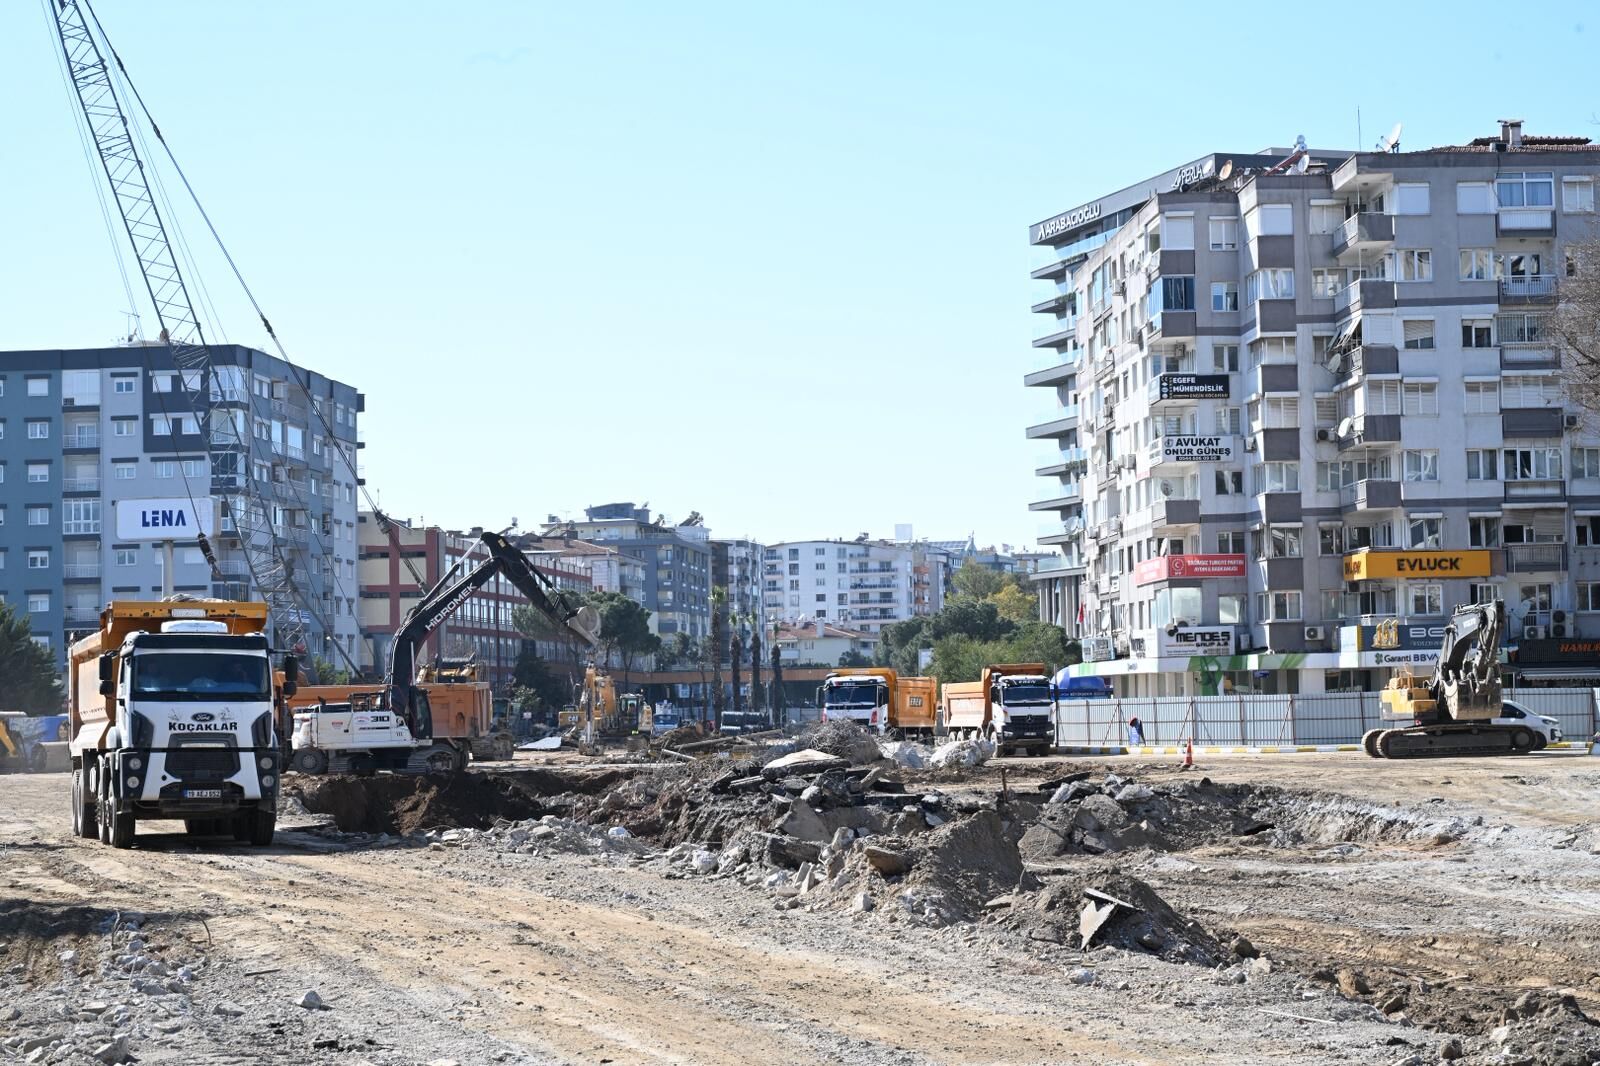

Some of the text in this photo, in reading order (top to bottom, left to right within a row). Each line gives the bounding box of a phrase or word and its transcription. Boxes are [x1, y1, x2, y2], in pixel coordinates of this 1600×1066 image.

[1181, 163, 1204, 186] PERLA
[1172, 384, 1224, 392] MÜHENDİSLİK
[1175, 437, 1221, 447] AVUKAT
[1196, 446, 1231, 456] GÜNEŞ
[141, 509, 187, 528] LENA
[1396, 557, 1460, 571] EVLUCK
[1384, 652, 1440, 663] Garanti BBVA
[168, 722, 238, 732] KOÇAKLAR
